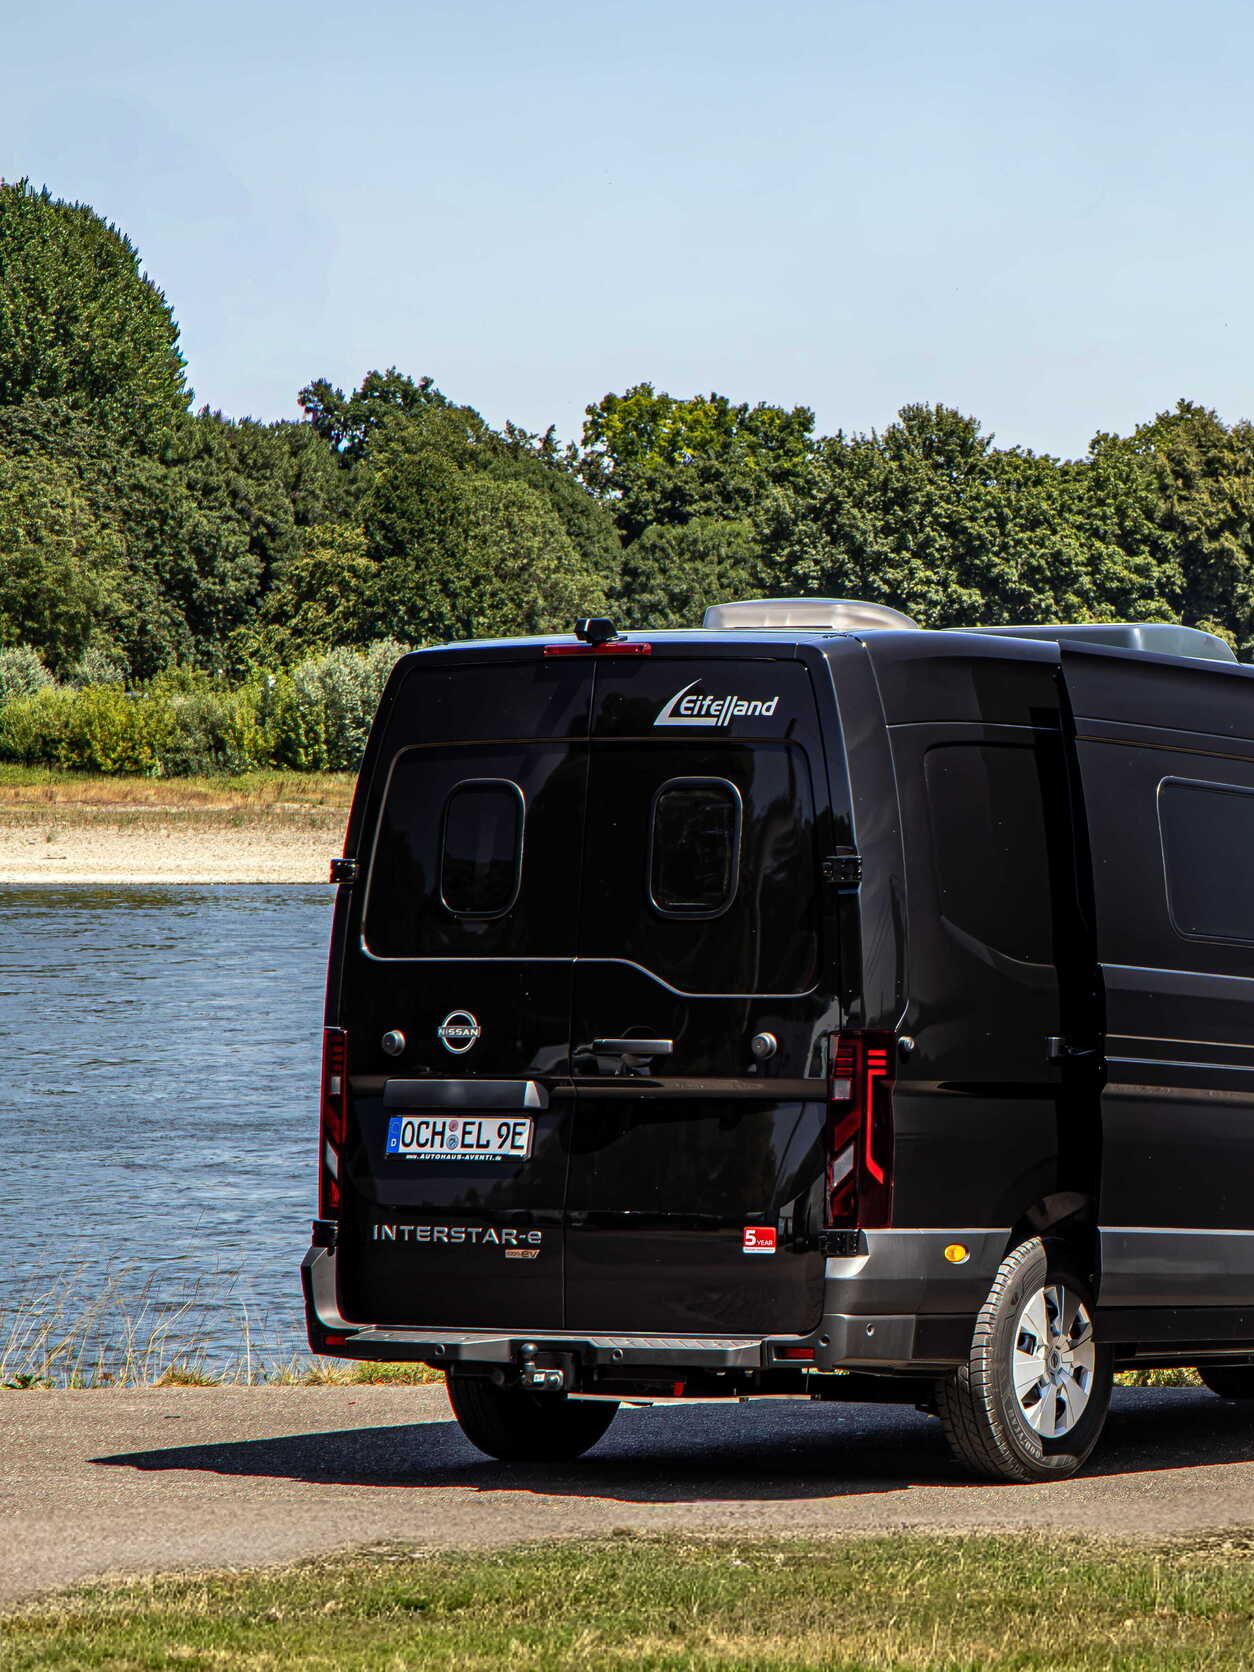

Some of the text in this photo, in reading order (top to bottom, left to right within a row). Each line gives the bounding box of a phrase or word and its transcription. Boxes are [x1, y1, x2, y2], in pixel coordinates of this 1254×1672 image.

[679, 695, 780, 726] Eifelland
[438, 1027, 479, 1036] NISSAN
[391, 1138, 398, 1147] D
[401, 1120, 526, 1150] OCH EL 9E
[372, 1224, 542, 1245] INTERSTAR-e
[744, 1229, 756, 1246] 5
